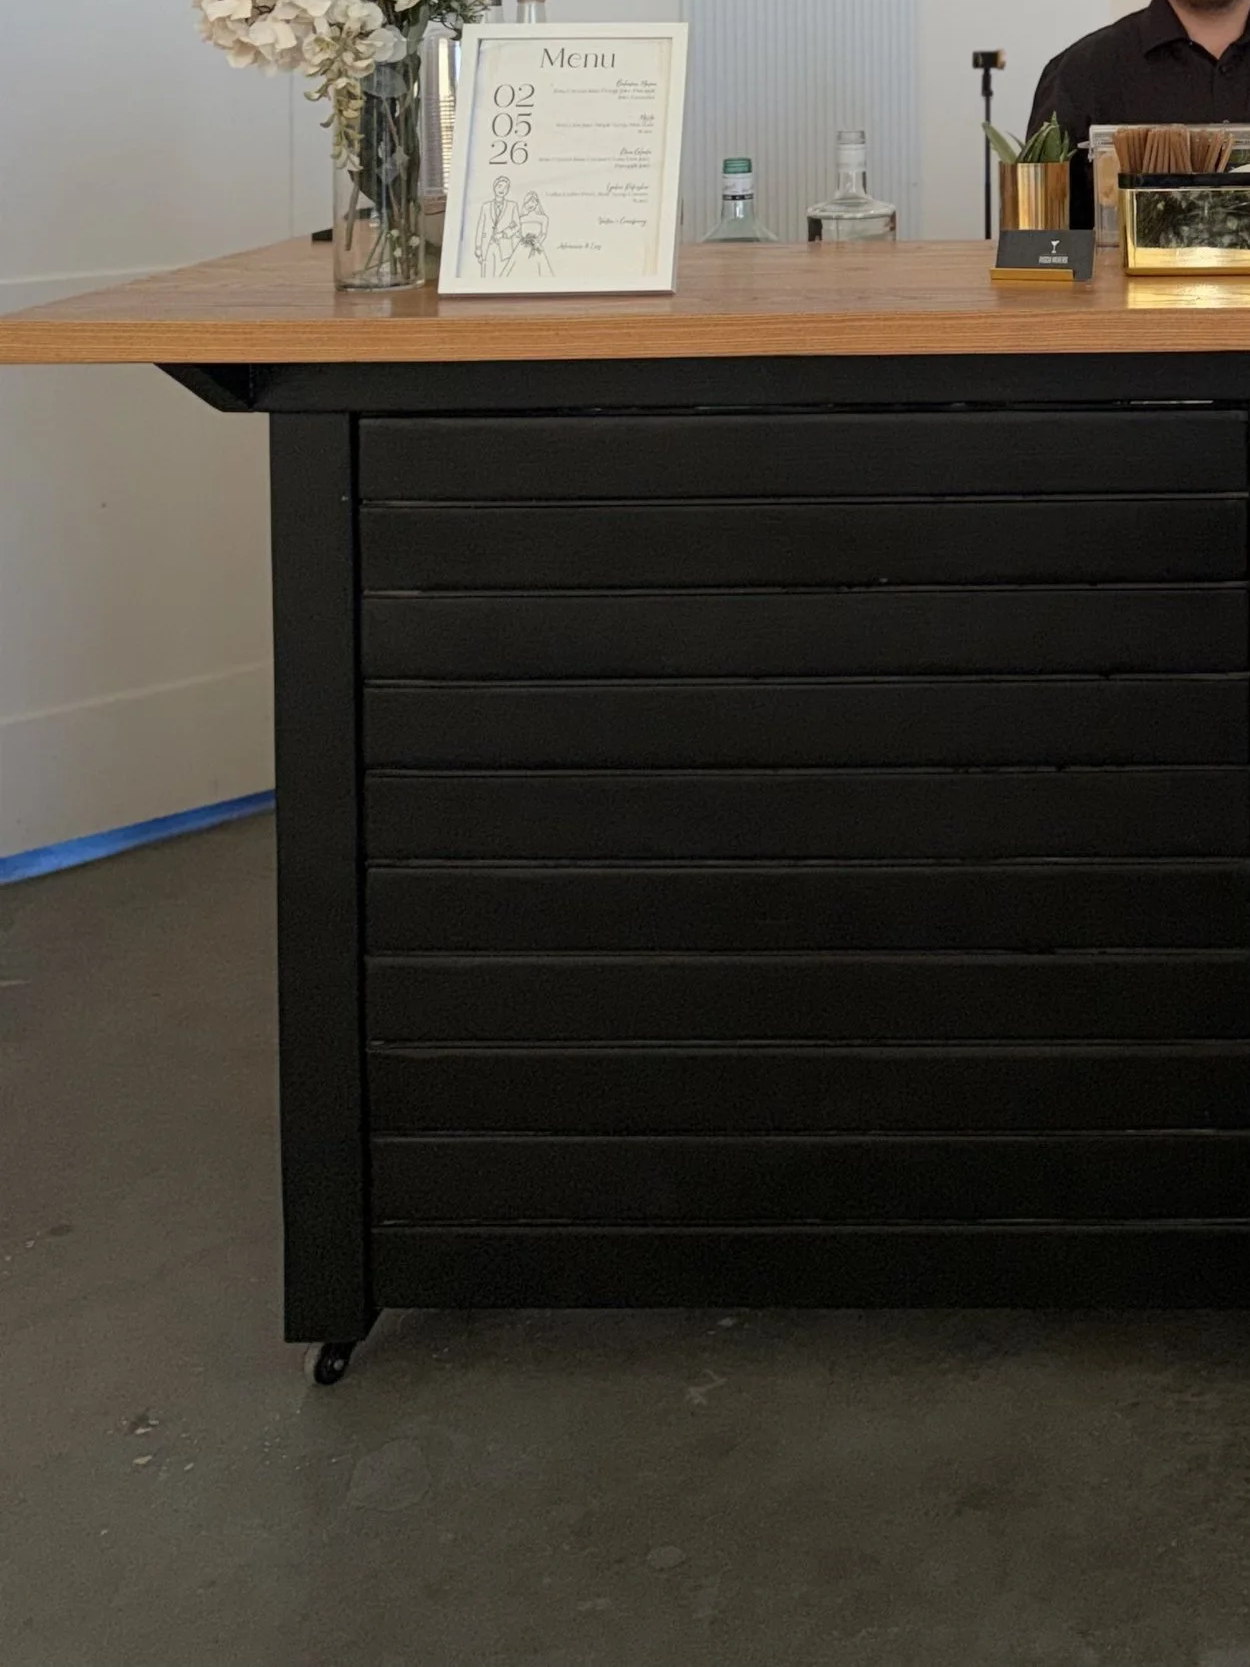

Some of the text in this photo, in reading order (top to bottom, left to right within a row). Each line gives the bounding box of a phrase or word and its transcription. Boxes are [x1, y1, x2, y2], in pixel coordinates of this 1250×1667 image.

[540, 47, 616, 69] Menu
[493, 83, 535, 108] 02
[491, 112, 532, 138] 05
[488, 139, 528, 165] 26
